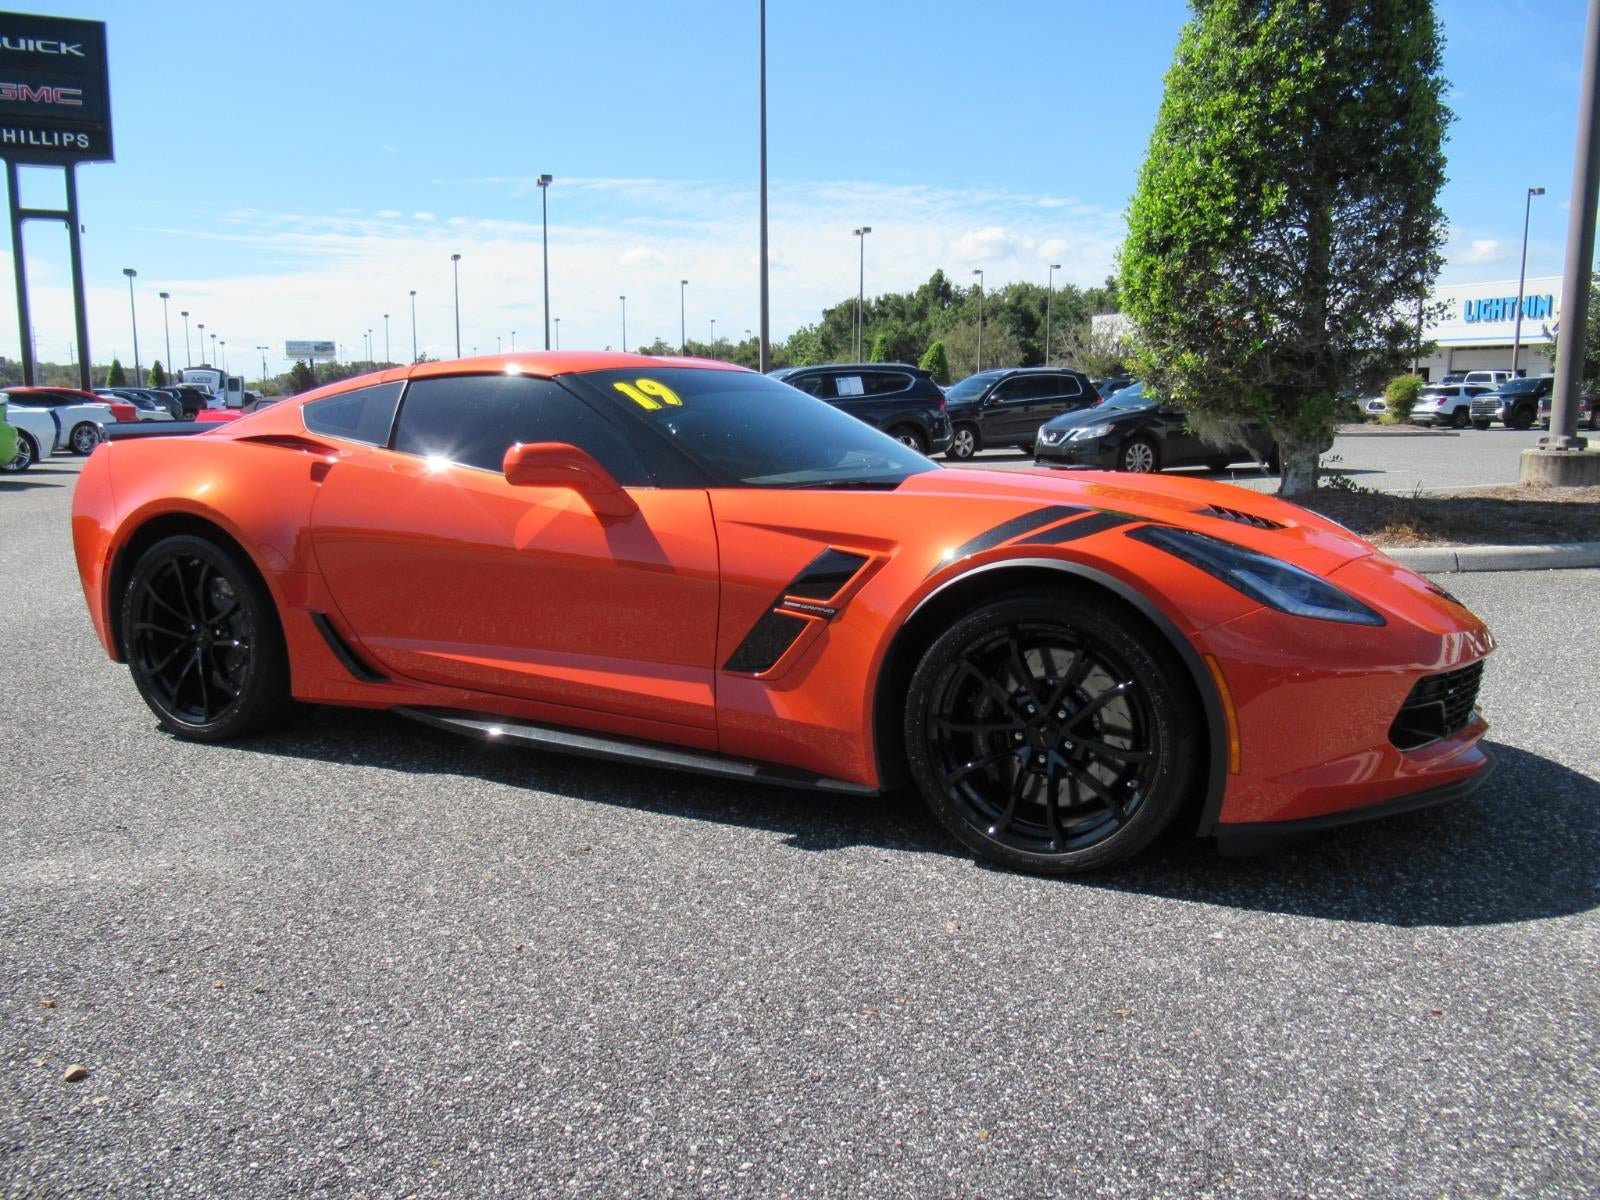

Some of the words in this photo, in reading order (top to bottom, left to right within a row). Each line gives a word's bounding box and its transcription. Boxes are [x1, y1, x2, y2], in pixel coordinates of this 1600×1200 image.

[0, 36, 85, 57] UICK
[0, 82, 83, 106] GMC
[2, 128, 89, 148] HILLIPS
[612, 379, 683, 410] 19
